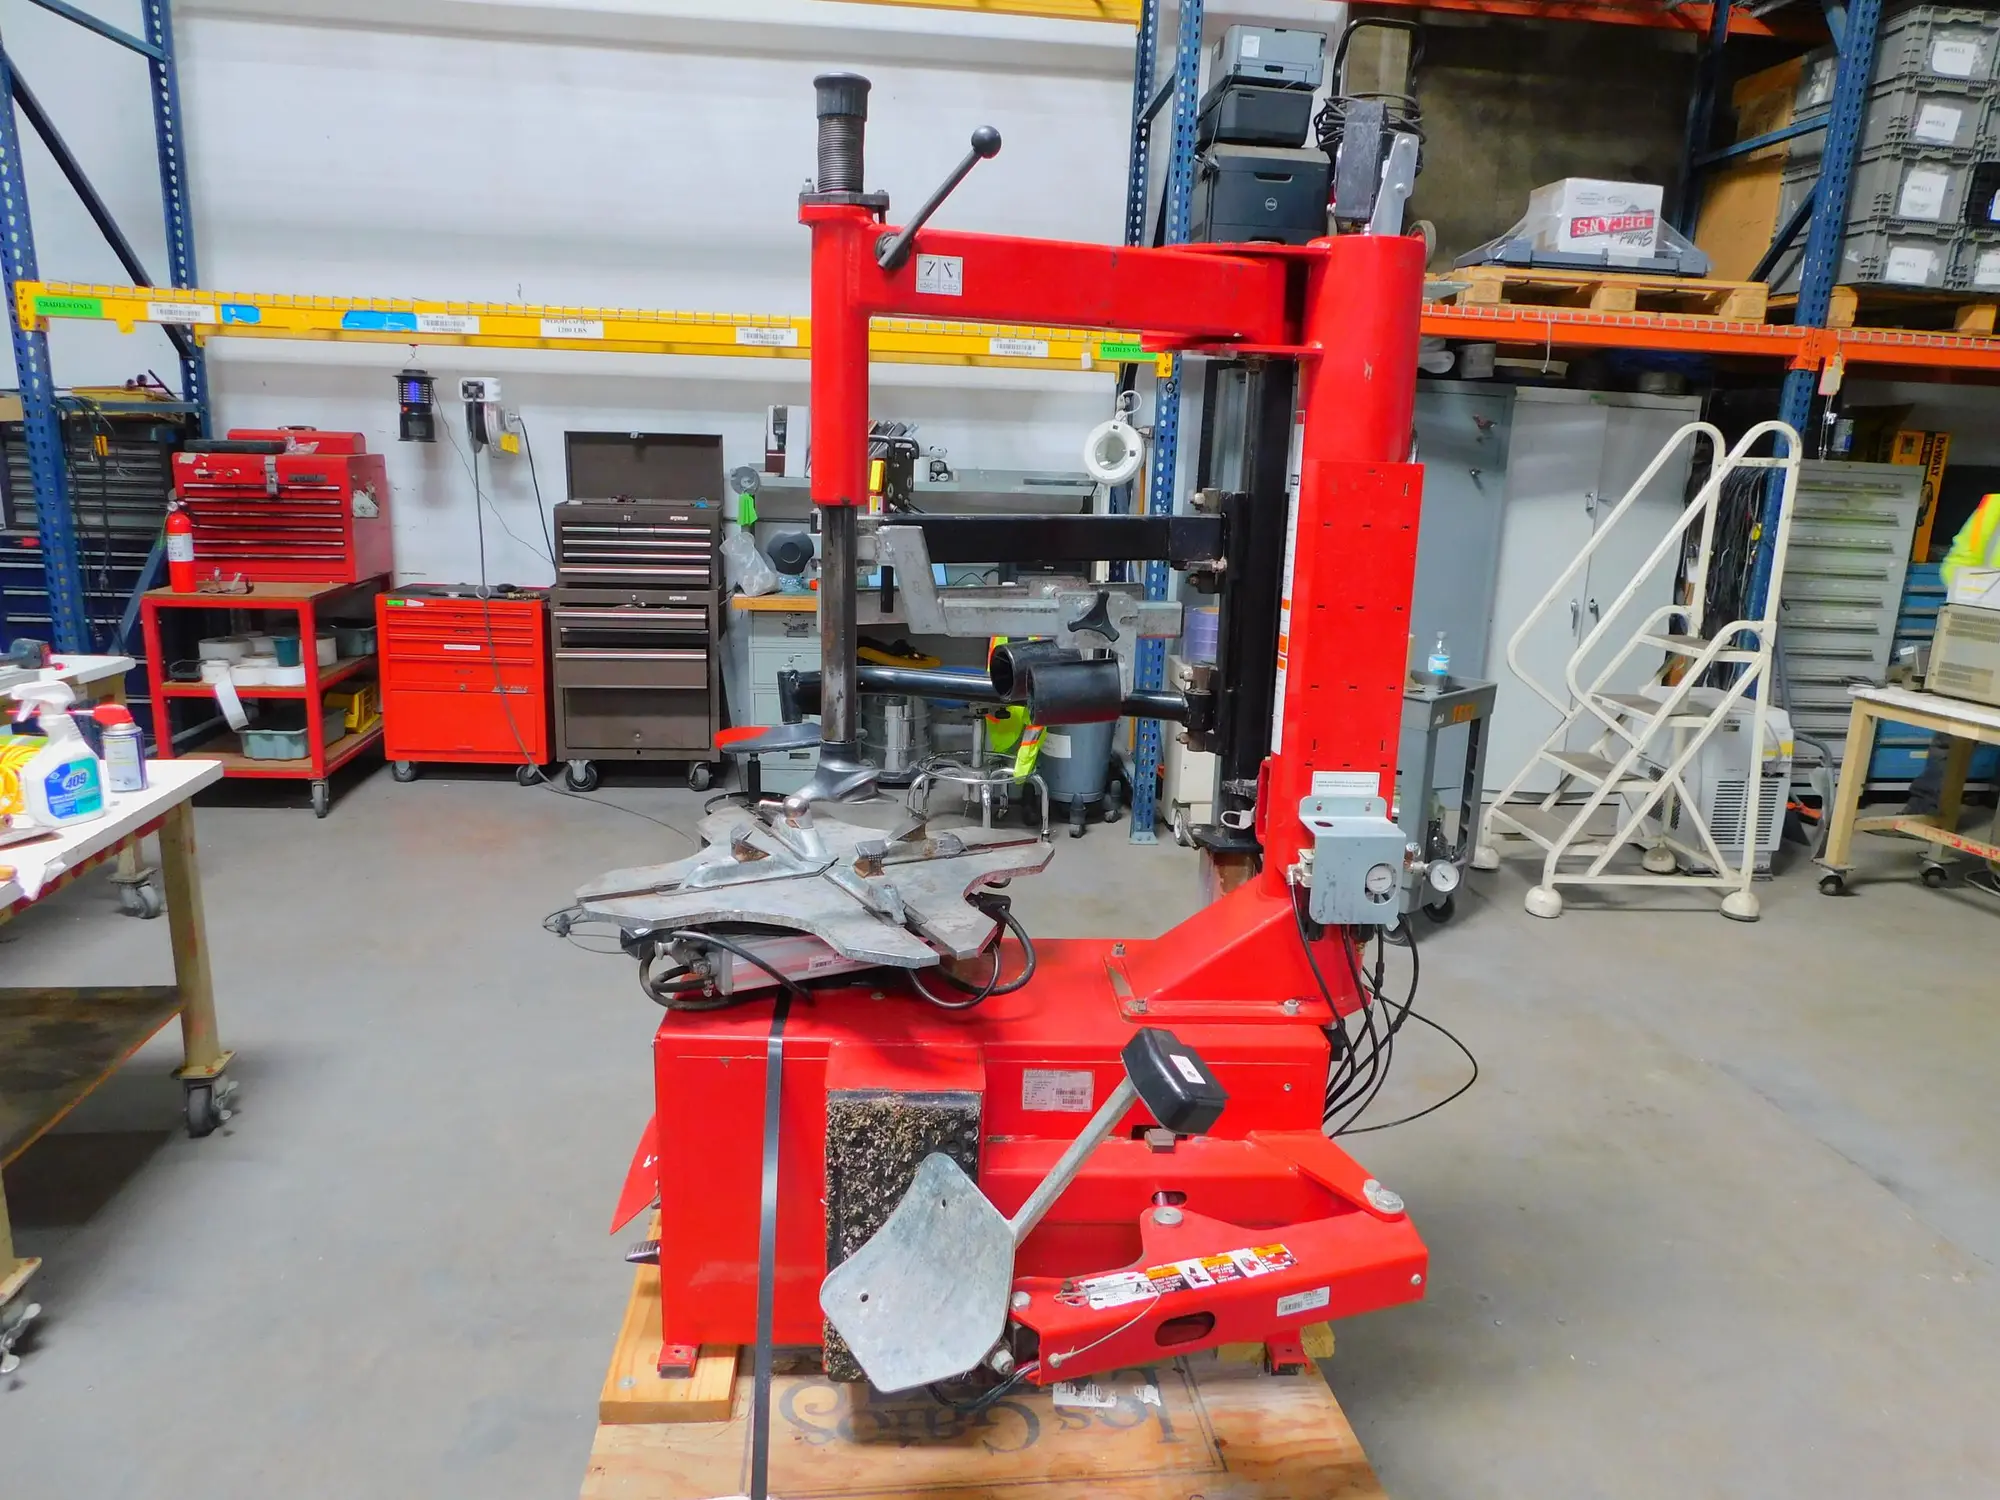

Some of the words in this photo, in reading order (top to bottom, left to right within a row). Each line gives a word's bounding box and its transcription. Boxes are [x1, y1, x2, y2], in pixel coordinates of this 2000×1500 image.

[1577, 217, 1646, 234] PECANS
[1619, 230, 1654, 247] Shelled
[65, 772, 87, 788] 409
